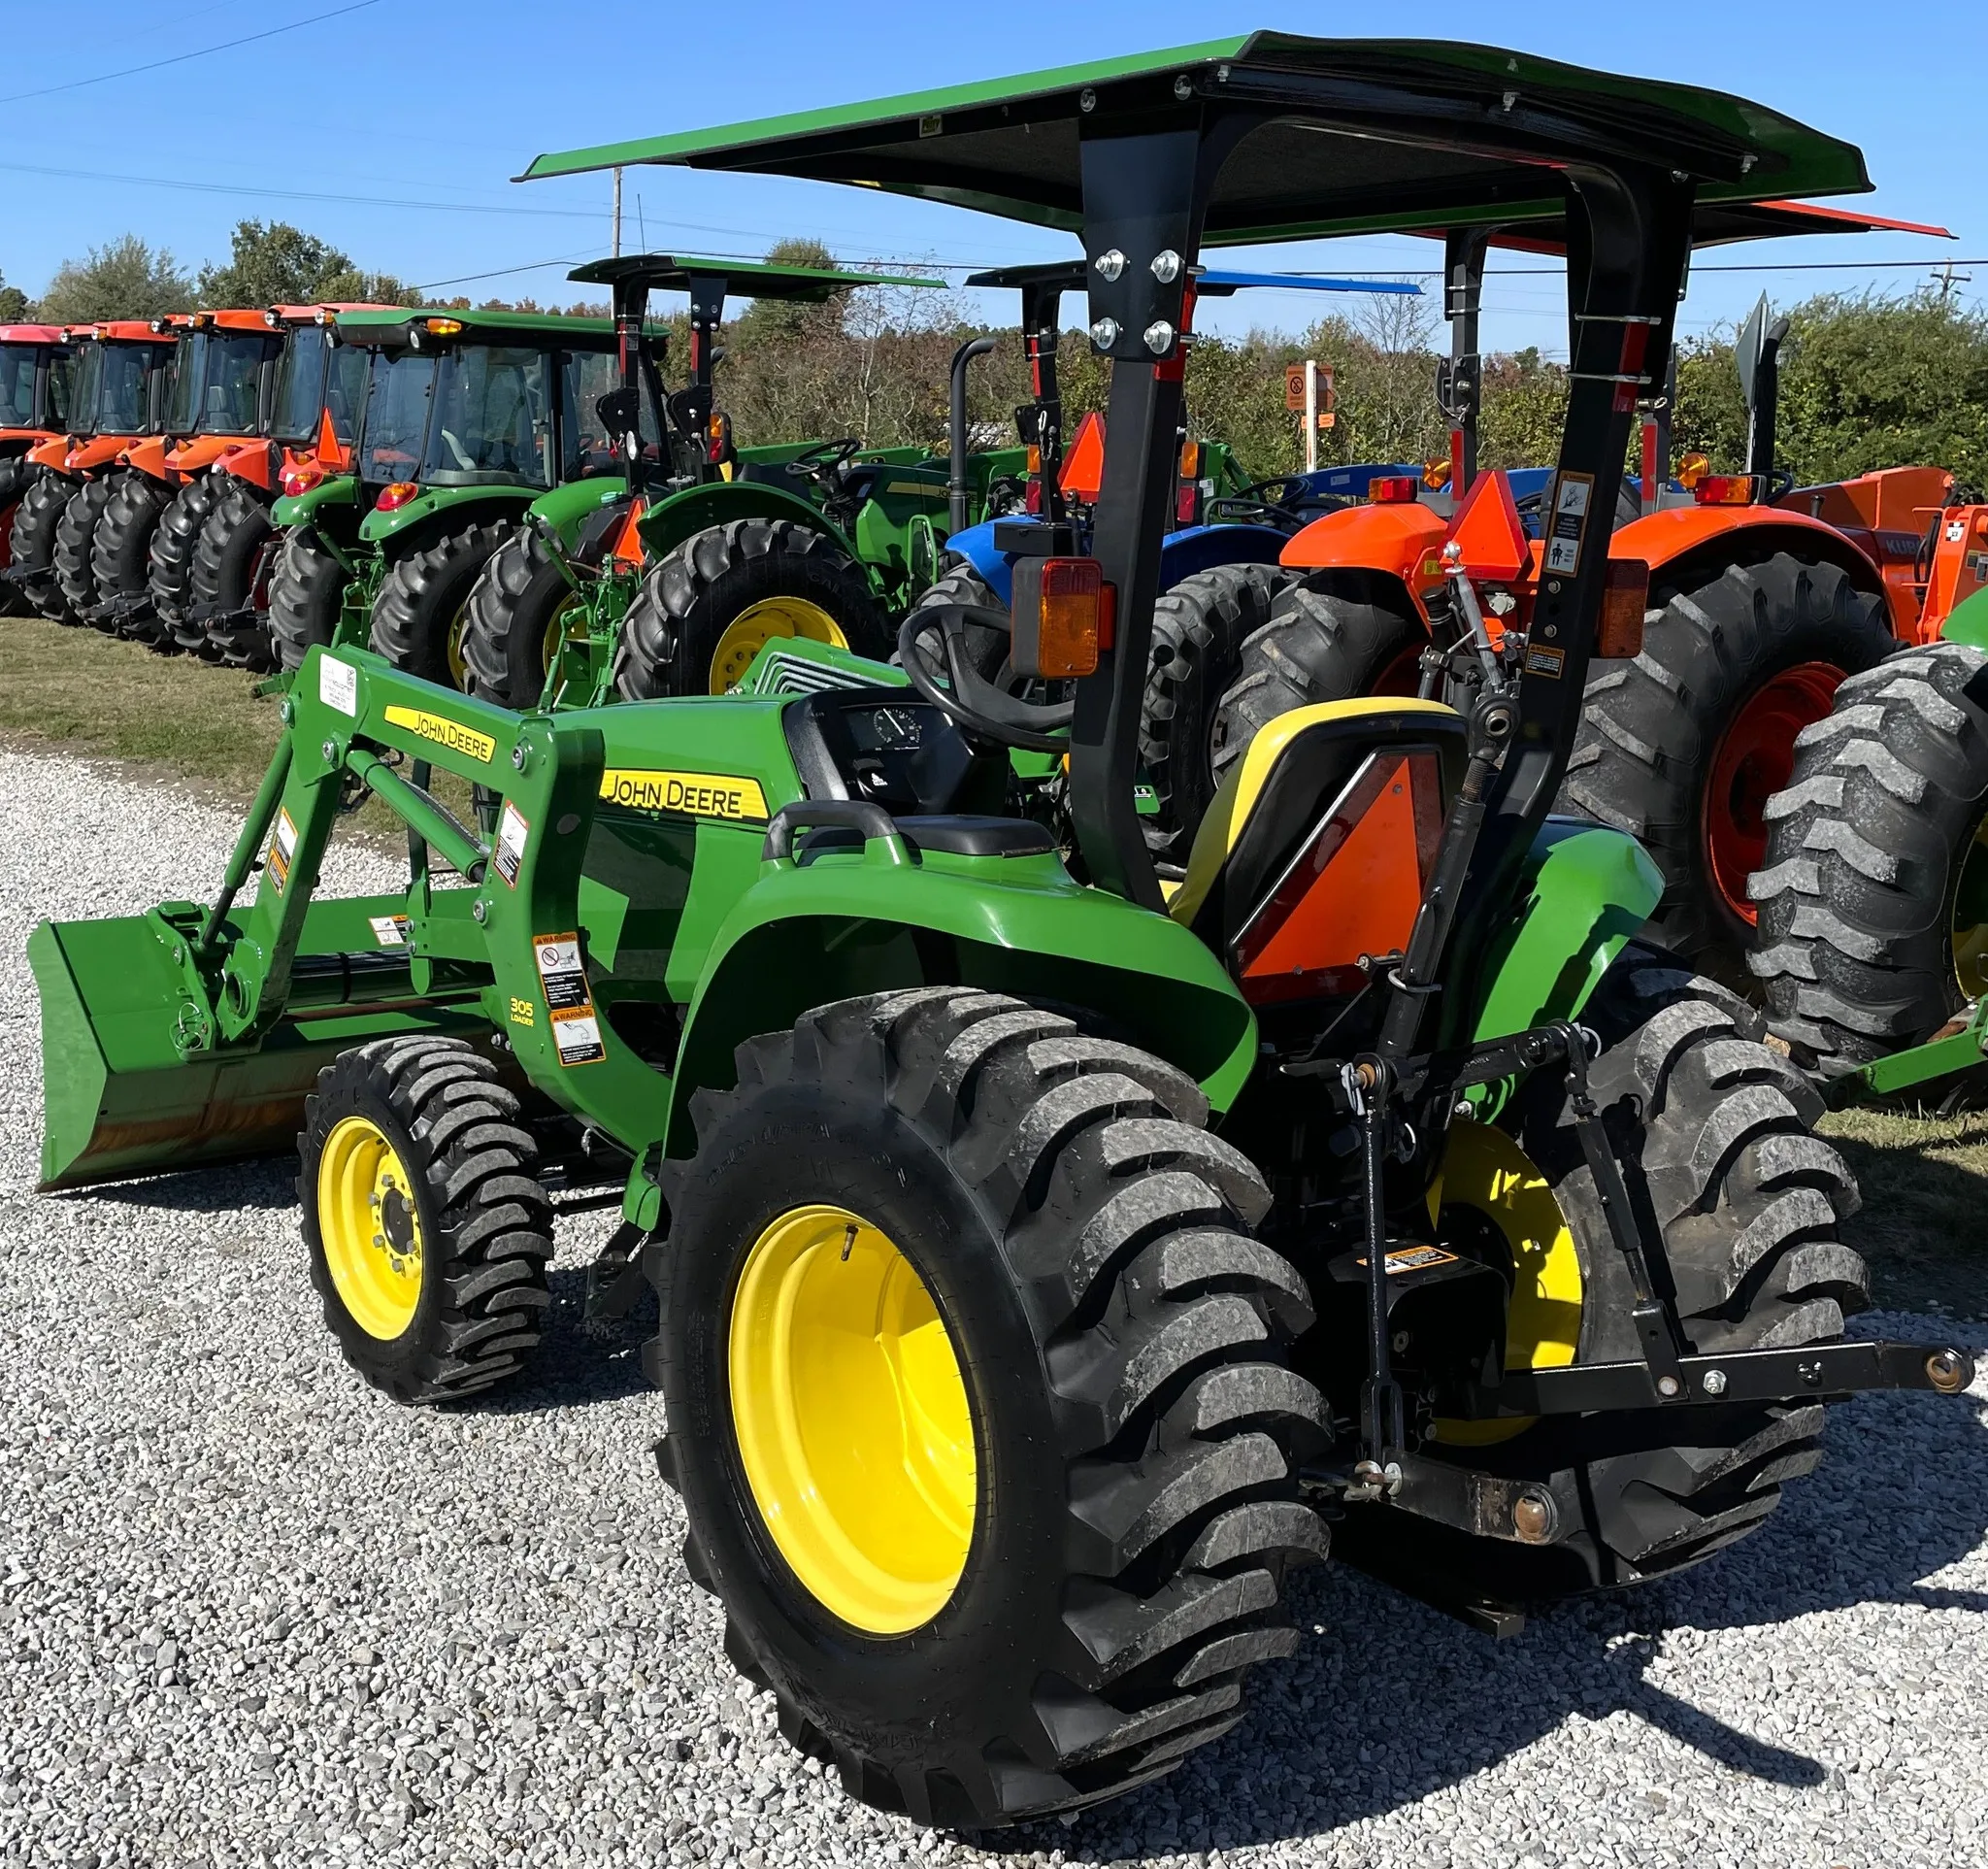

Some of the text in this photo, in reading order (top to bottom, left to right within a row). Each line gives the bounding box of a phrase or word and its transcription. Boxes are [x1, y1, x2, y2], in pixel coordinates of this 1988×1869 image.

[1886, 539, 1921, 554] KUB
[414, 714, 488, 758] JOHN DEERE
[607, 775, 742, 814] JOHN DEERE
[543, 933, 576, 943] WARNING
[511, 997, 533, 1017] 305
[511, 1014, 534, 1027] LOADER
[559, 1010, 593, 1020] WARNING
